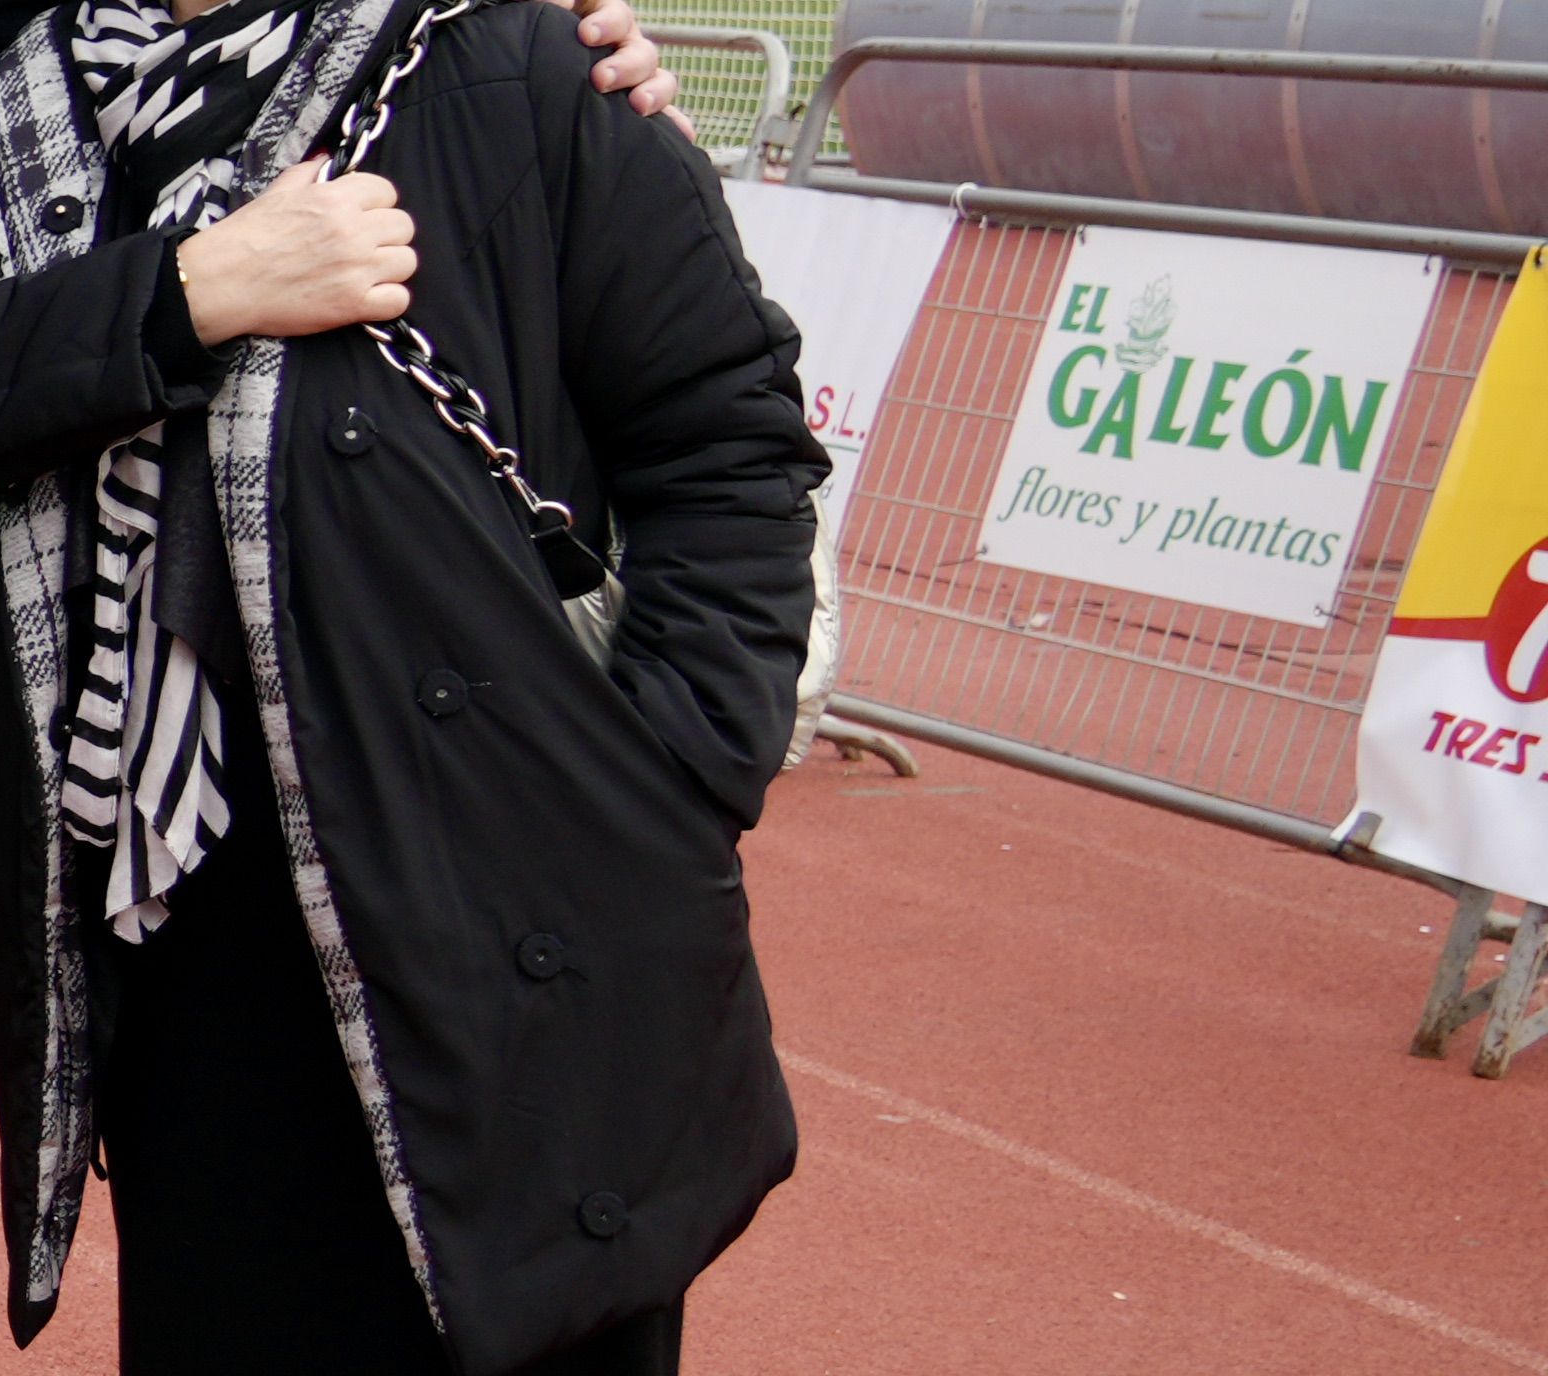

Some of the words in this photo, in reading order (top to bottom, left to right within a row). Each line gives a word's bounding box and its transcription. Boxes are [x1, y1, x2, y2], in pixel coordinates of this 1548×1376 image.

[1057, 282, 1111, 335] EL
[1046, 343, 1389, 473] GALEÓN
[997, 465, 1121, 529] flores
[1119, 502, 1159, 545] y
[1157, 497, 1341, 569] plantas
[1422, 710, 1542, 775] TRES
